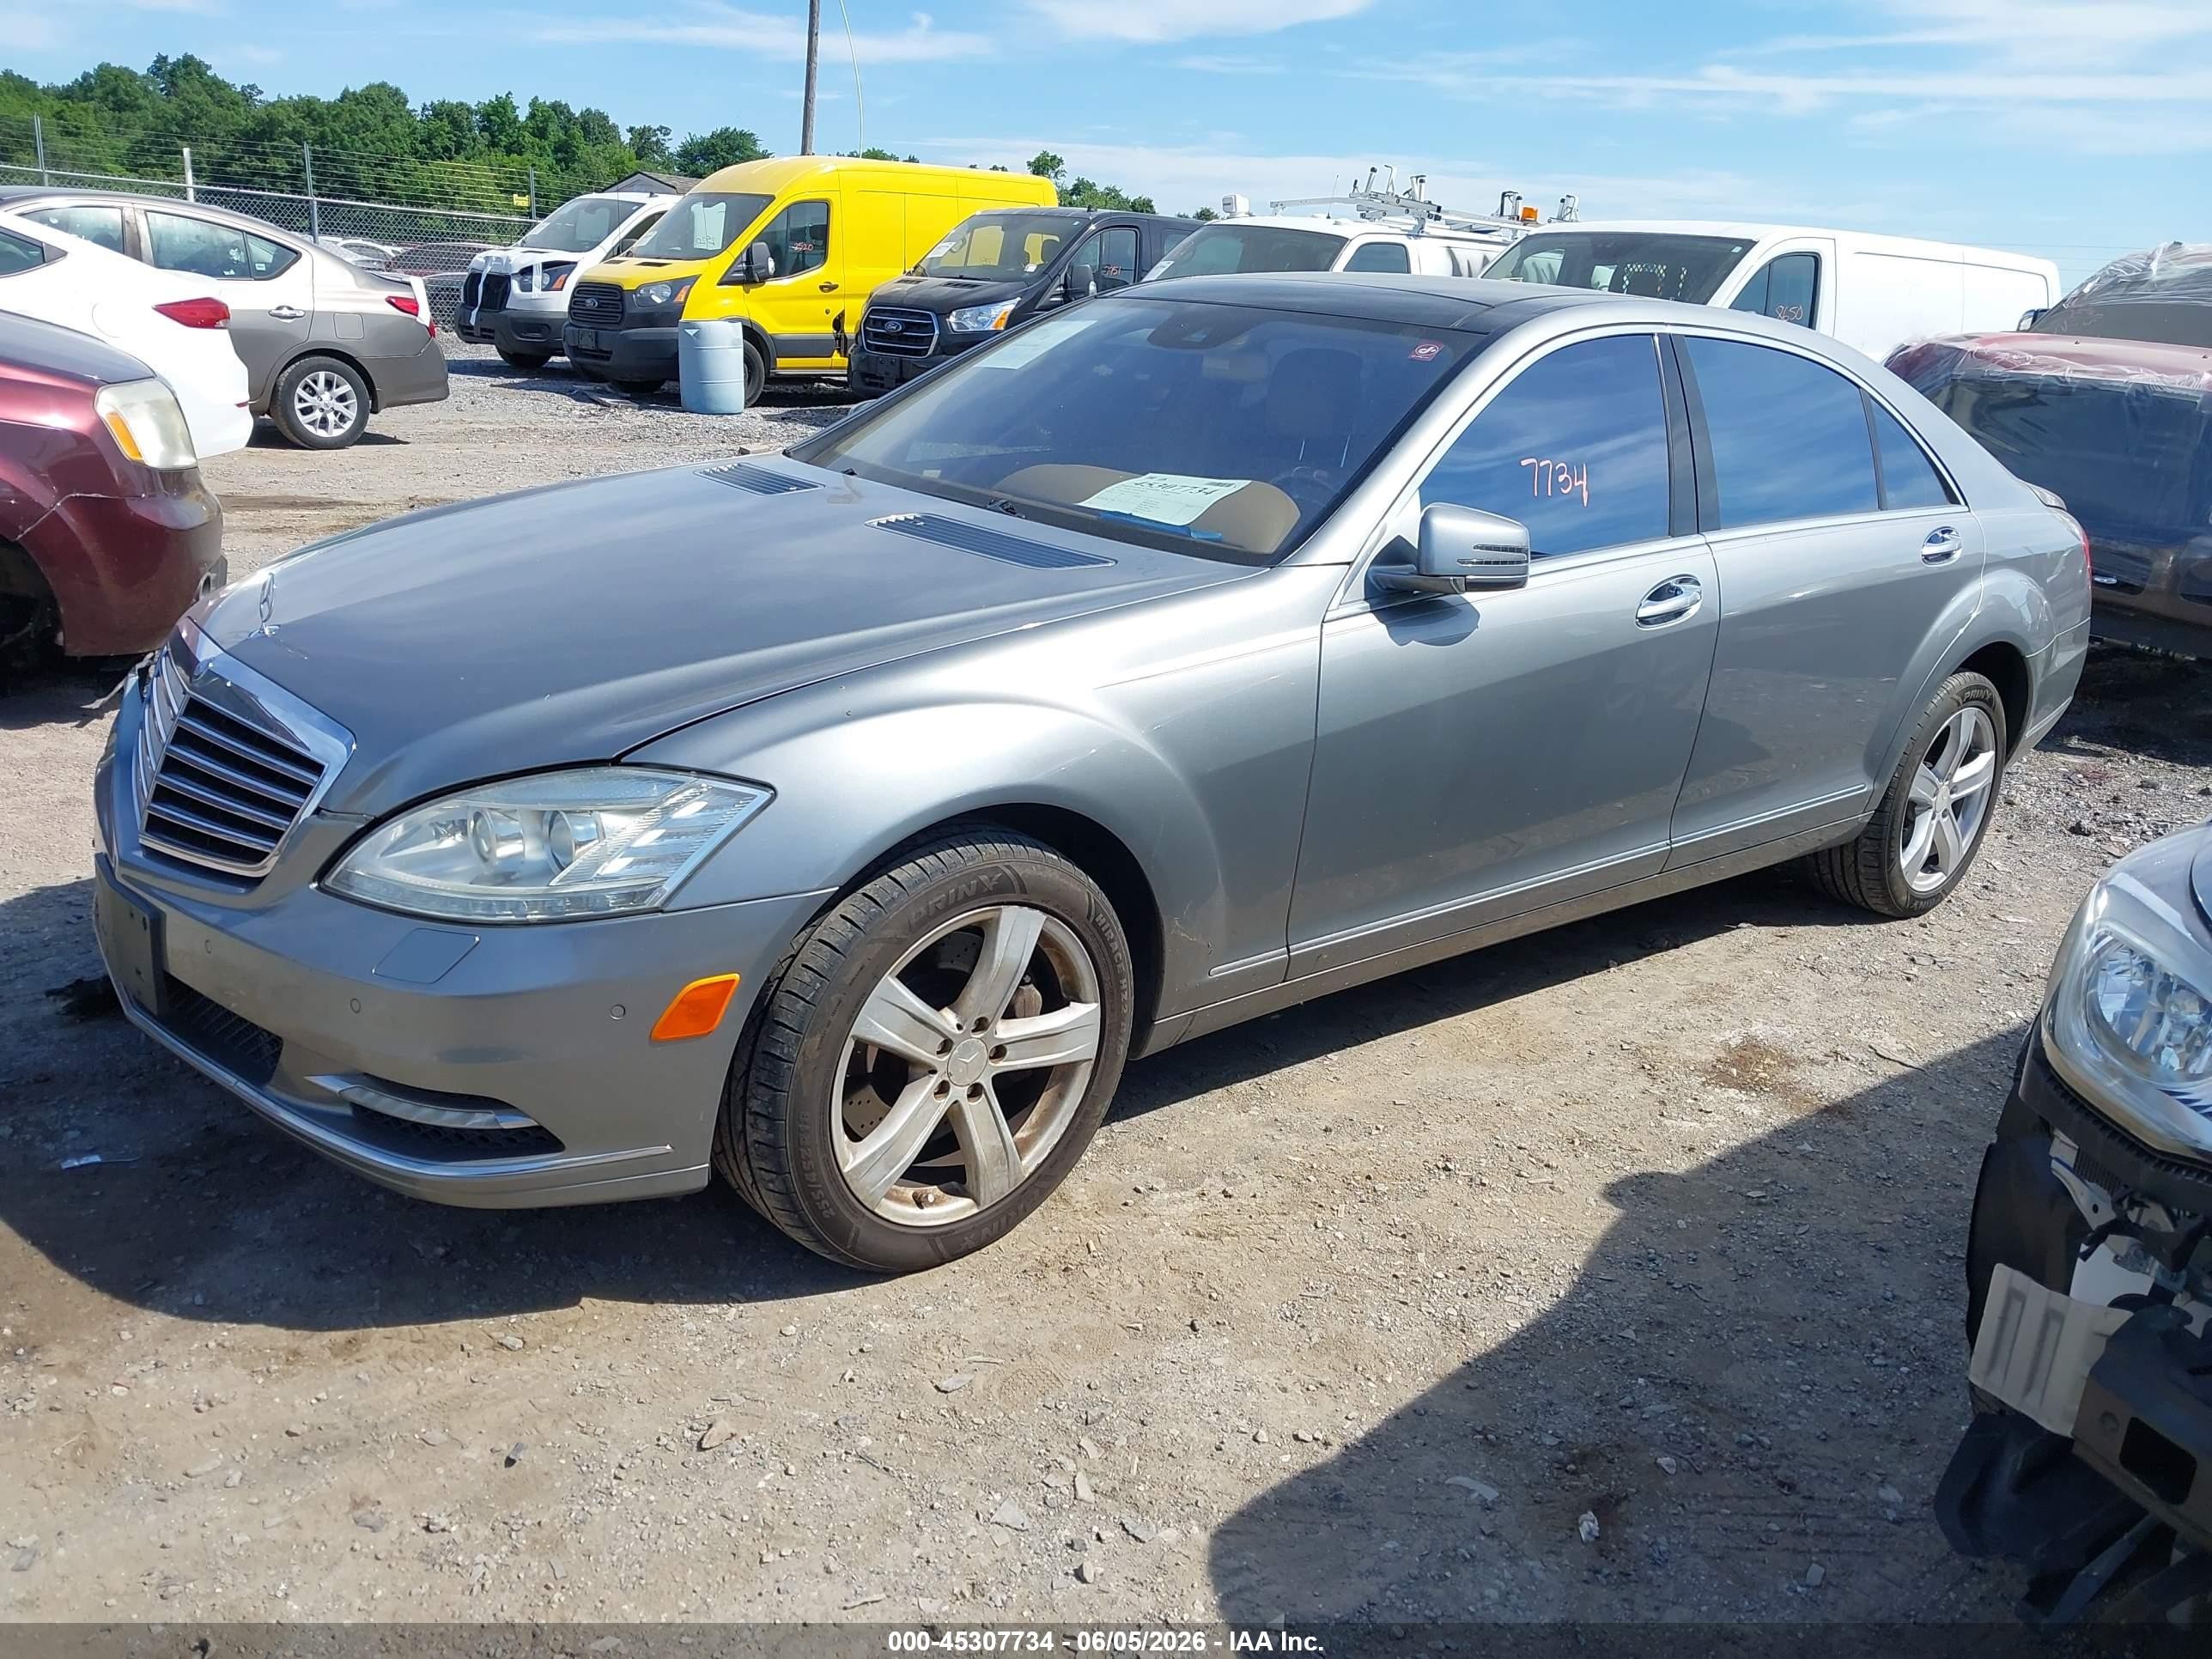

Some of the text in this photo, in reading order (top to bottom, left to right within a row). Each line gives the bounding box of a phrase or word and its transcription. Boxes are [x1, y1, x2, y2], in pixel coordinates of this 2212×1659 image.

[1133, 481, 1220, 495] 45307734
[1519, 458, 1589, 508] 7734
[1095, 913, 1126, 975] HIRACE
